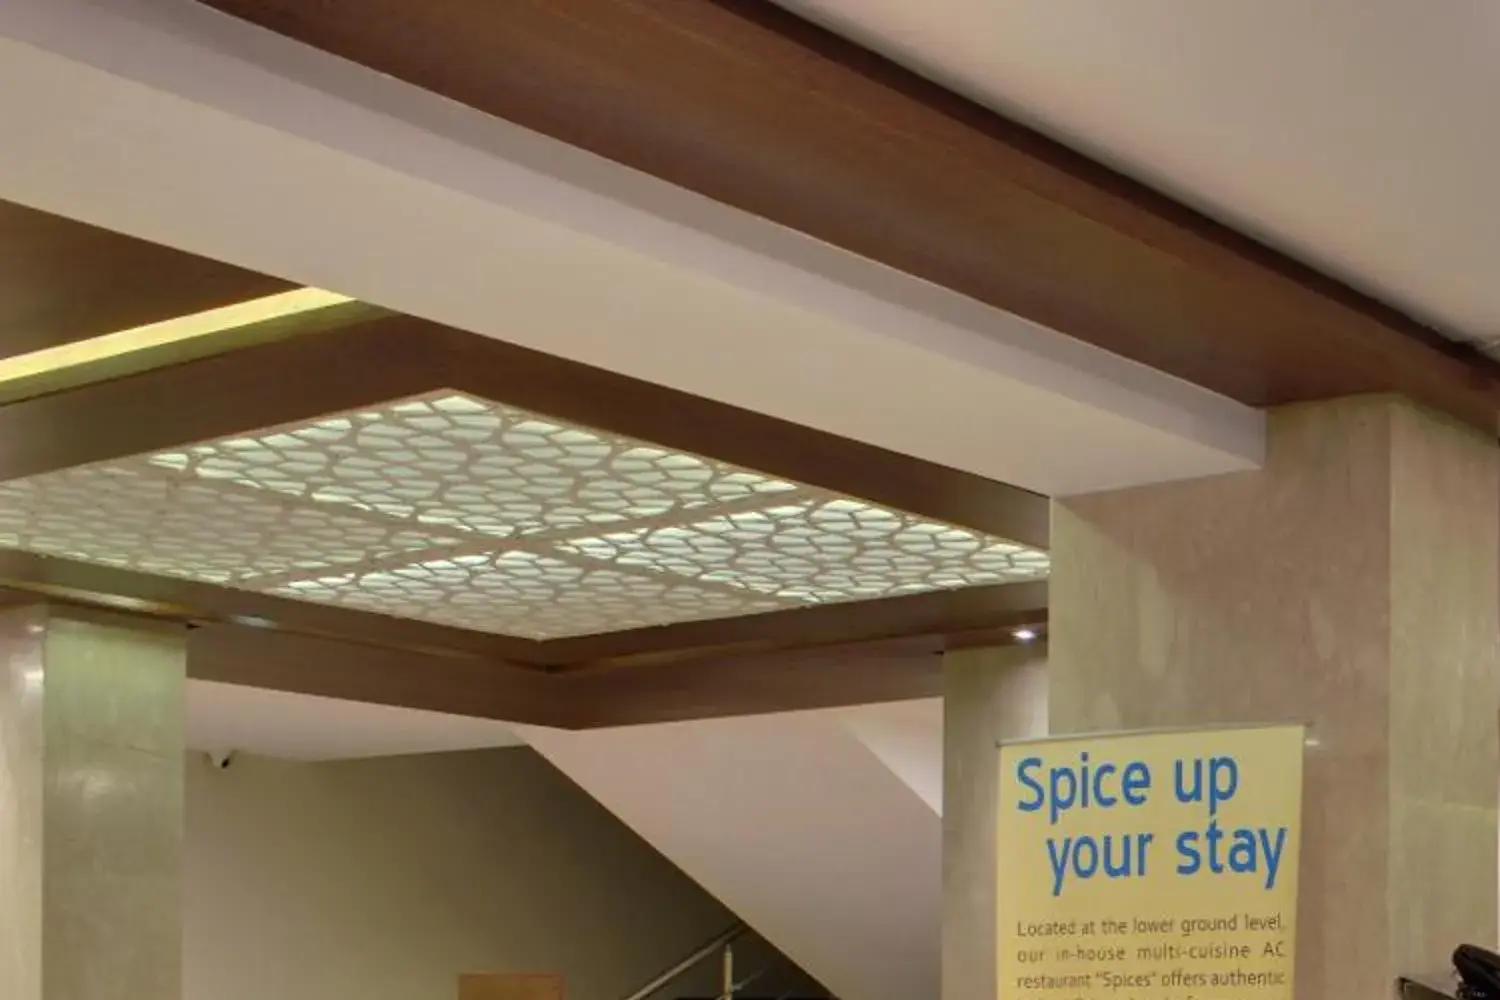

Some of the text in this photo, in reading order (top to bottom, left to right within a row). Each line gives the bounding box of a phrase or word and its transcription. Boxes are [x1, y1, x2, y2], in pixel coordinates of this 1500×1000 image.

[1016, 752, 1238, 825] Spice up
[1047, 820, 1286, 896] your stay
[1017, 920, 1076, 937] Located
[1082, 920, 1095, 934] at
[1102, 918, 1128, 934] the
[1133, 918, 1174, 934] lower
[1181, 916, 1238, 936] ground
[1017, 942, 1286, 962] our in-house multi-cuisine AC
[1016, 974, 1090, 989] restaurant
[1162, 970, 1206, 986] offers
[1211, 969, 1284, 985] authentic
